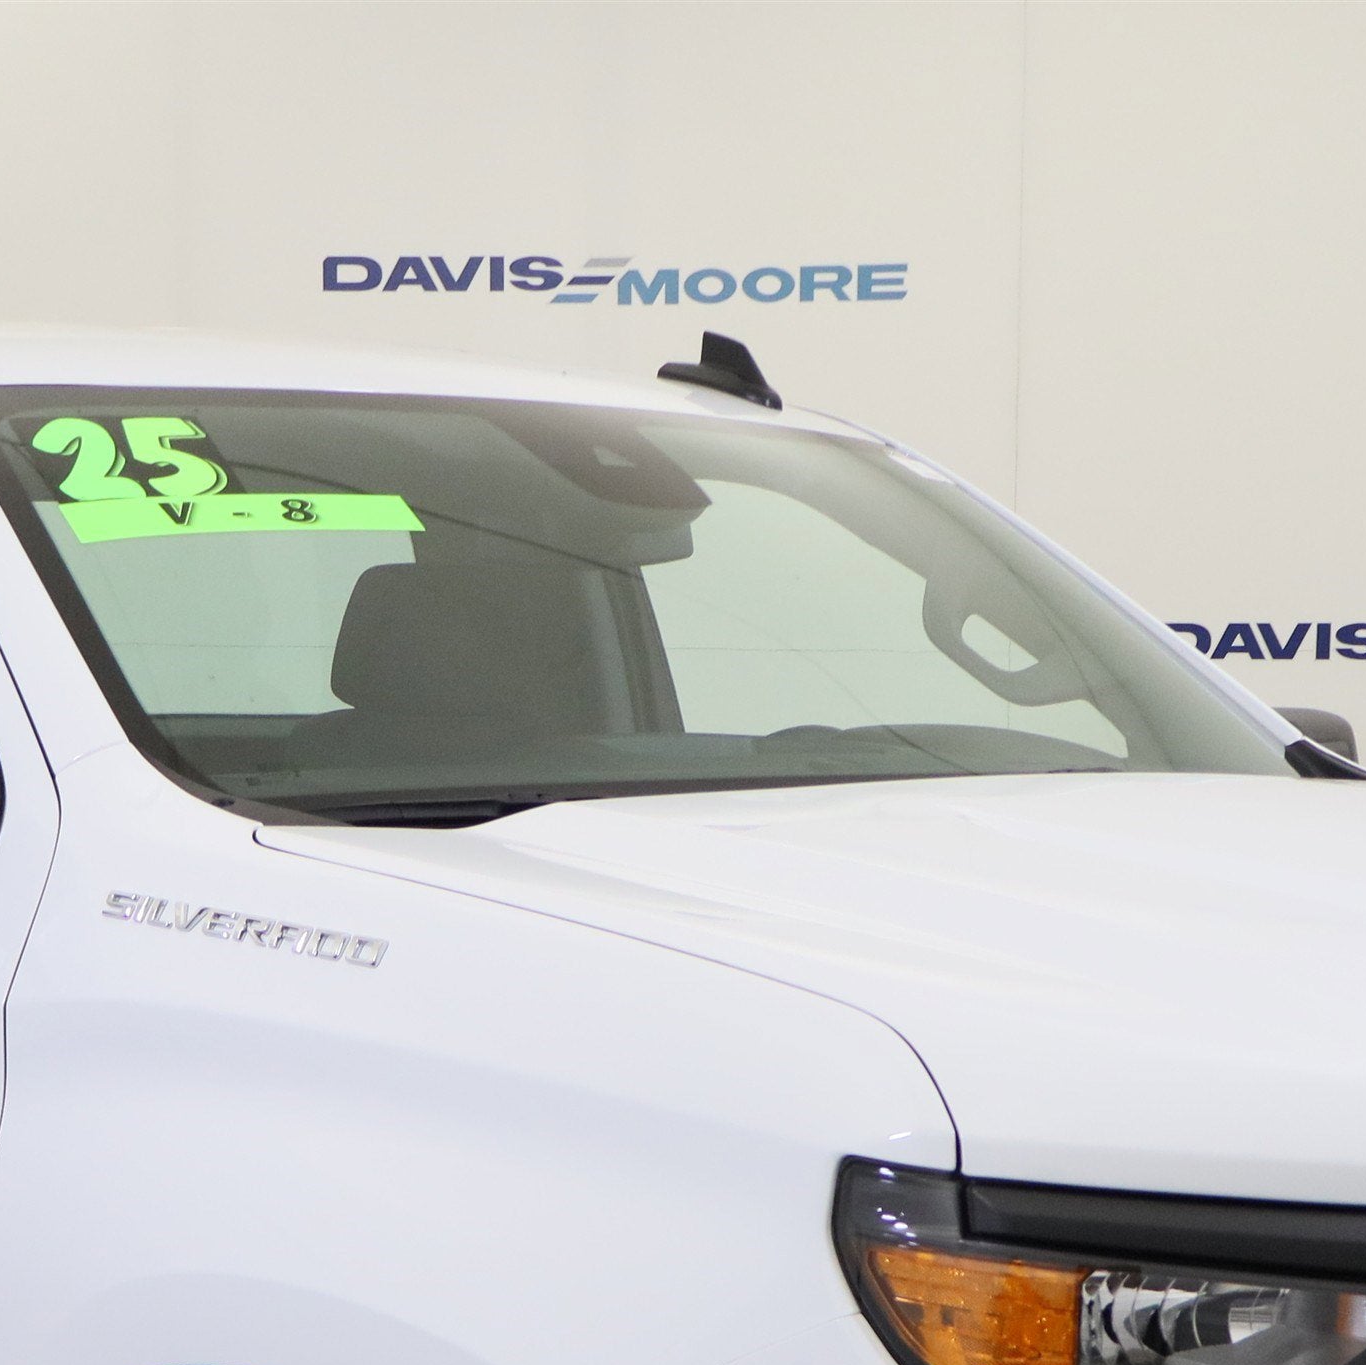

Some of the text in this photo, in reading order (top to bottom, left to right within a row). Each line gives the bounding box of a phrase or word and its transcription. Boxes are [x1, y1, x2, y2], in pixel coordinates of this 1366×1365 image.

[323, 255, 908, 305] DAVIS MOORE
[32, 416, 228, 500] 25
[102, 890, 390, 969] SILVERADO
